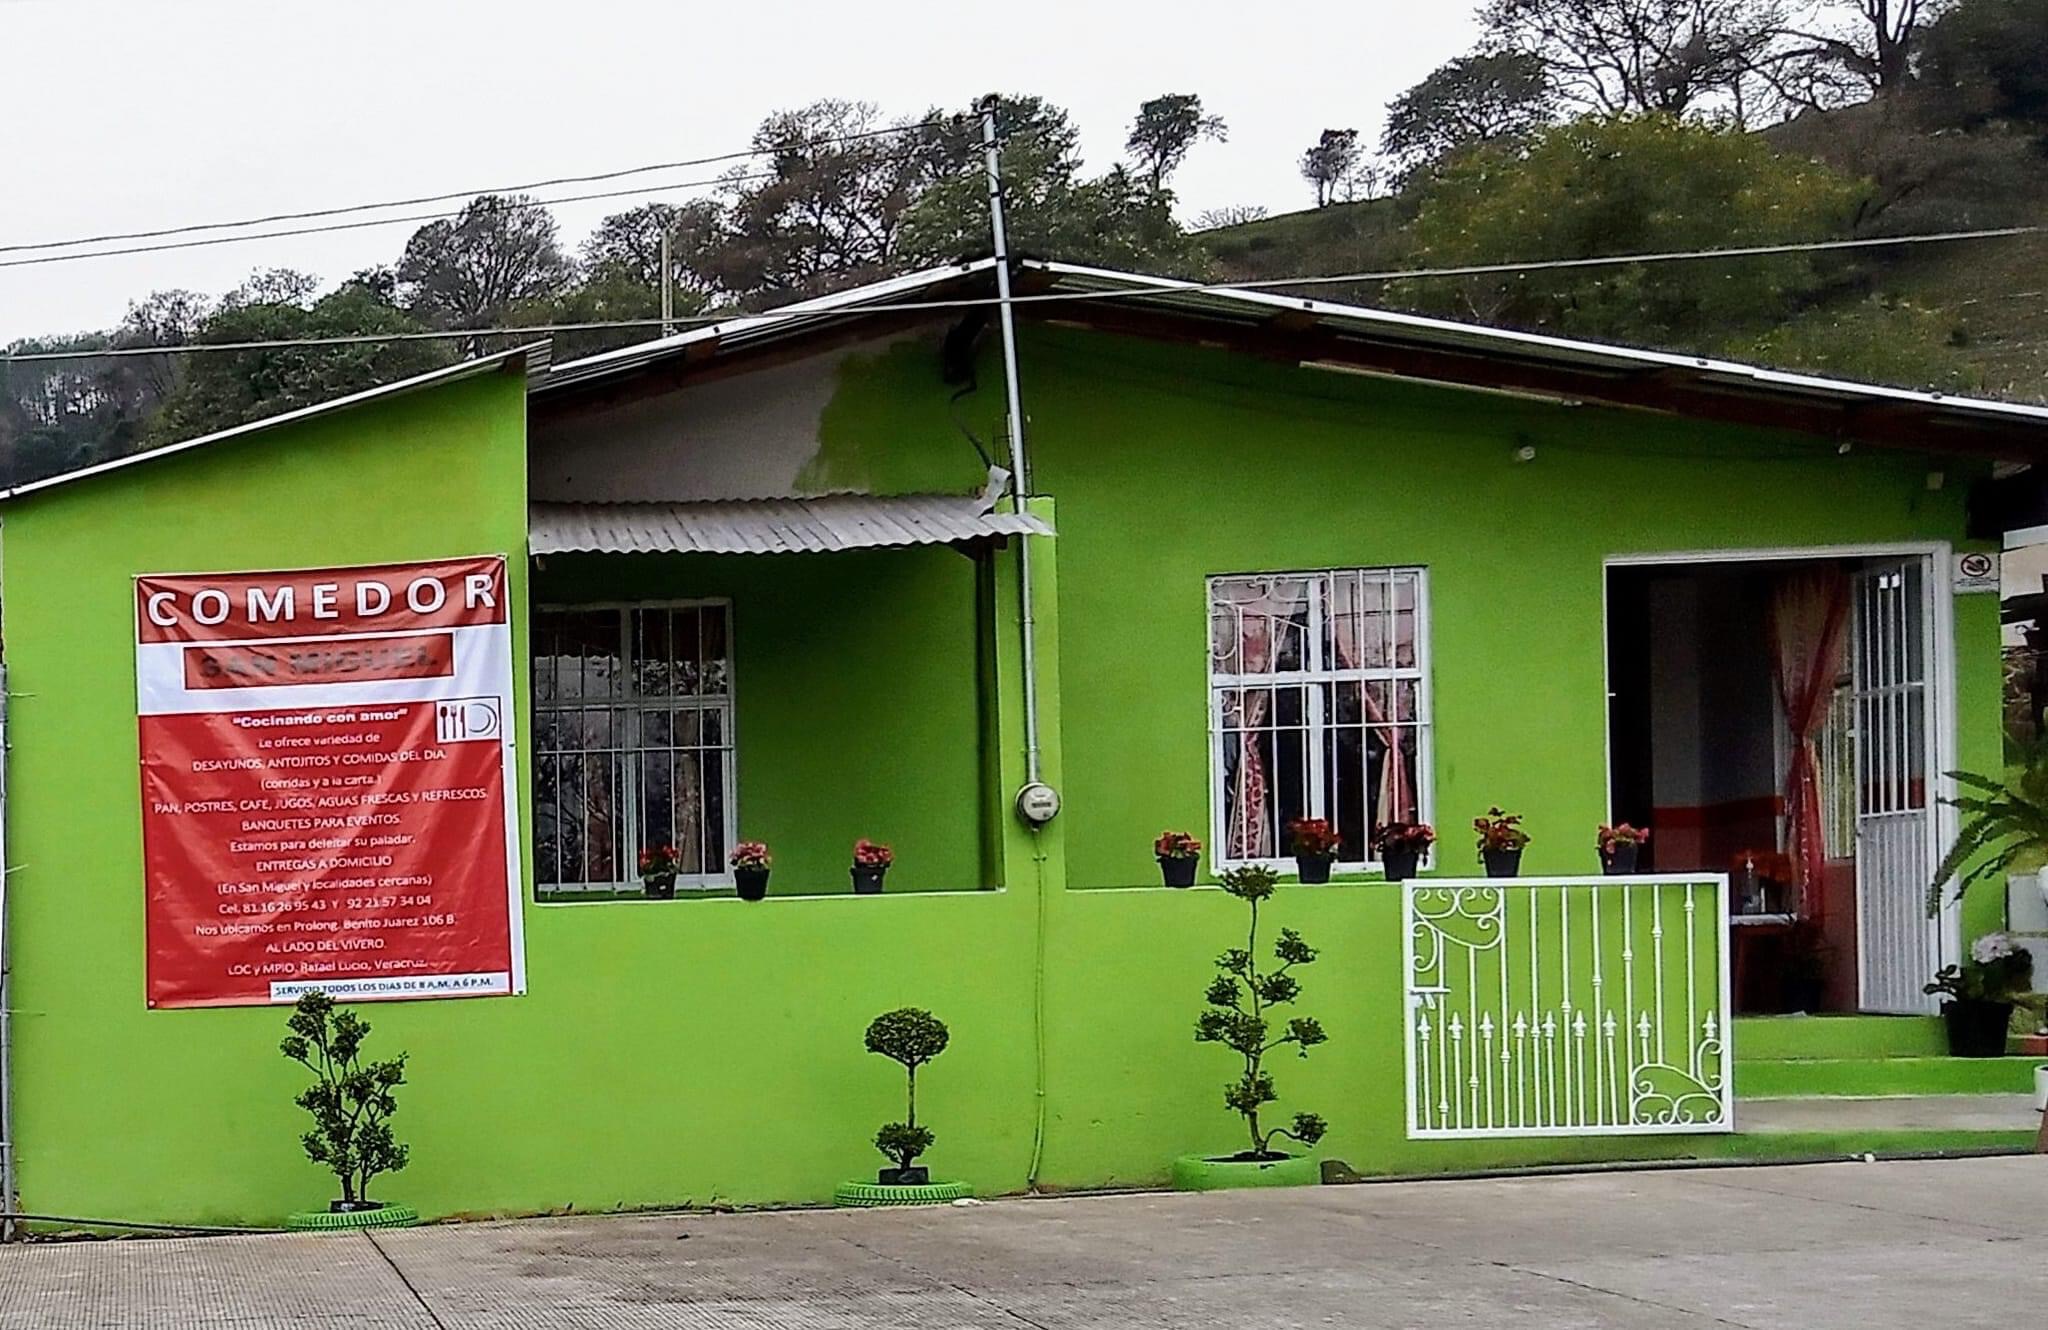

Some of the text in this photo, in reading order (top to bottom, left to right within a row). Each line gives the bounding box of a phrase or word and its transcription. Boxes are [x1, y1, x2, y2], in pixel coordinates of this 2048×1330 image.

[148, 574, 496, 627] COMEDOR
[326, 711, 356, 723] con
[258, 733, 381, 748] Le ofrece variedad de
[192, 759, 265, 772] DESAYUNOS,
[267, 756, 331, 768] ANTOJITOS
[332, 756, 341, 765] Y
[342, 751, 397, 764] COMIDAS
[399, 750, 422, 762] DEL
[312, 779, 320, 788] y
[322, 778, 330, 786] a
[332, 776, 343, 786] la
[154, 803, 182, 815] PAN,
[184, 800, 238, 813] POSTRES,
[275, 798, 314, 810] JUGOS,
[318, 796, 359, 808] AGUAS
[361, 792, 410, 805] FRESCAS
[412, 792, 420, 801] Y
[242, 818, 311, 831] BANQUETES
[314, 817, 345, 829] PARA
[230, 834, 416, 853] Estamos para deleitar su paladar.
[256, 855, 393, 872] ENTREGAS A DOMICILIO
[217, 874, 433, 895] (En San Miguel y localidades cercanas)
[219, 895, 432, 914] Cel. 81 16 26 95 43 Y 92 21 57 34 04
[195, 925, 218, 936] Nos
[220, 922, 275, 935] ubicamos
[277, 922, 292, 932] en
[343, 918, 381, 930] Benito
[382, 917, 419, 928] Juarez
[422, 914, 444, 926] 106
[265, 942, 281, 953] AL
[283, 941, 315, 953] LADO
[317, 940, 340, 951] DEL
[228, 964, 252, 975] LOC
[253, 966, 261, 976] y
[301, 961, 336, 972] Rafael
[276, 984, 320, 995] SERVICIO
[323, 983, 356, 993] TODOS
[358, 983, 376, 992] LOS
[378, 981, 401, 991] DIAS
[403, 981, 417, 990] DE
[450, 979, 459, 987] A
[462, 978, 469, 987] 6
[470, 978, 493, 987] P.M.
